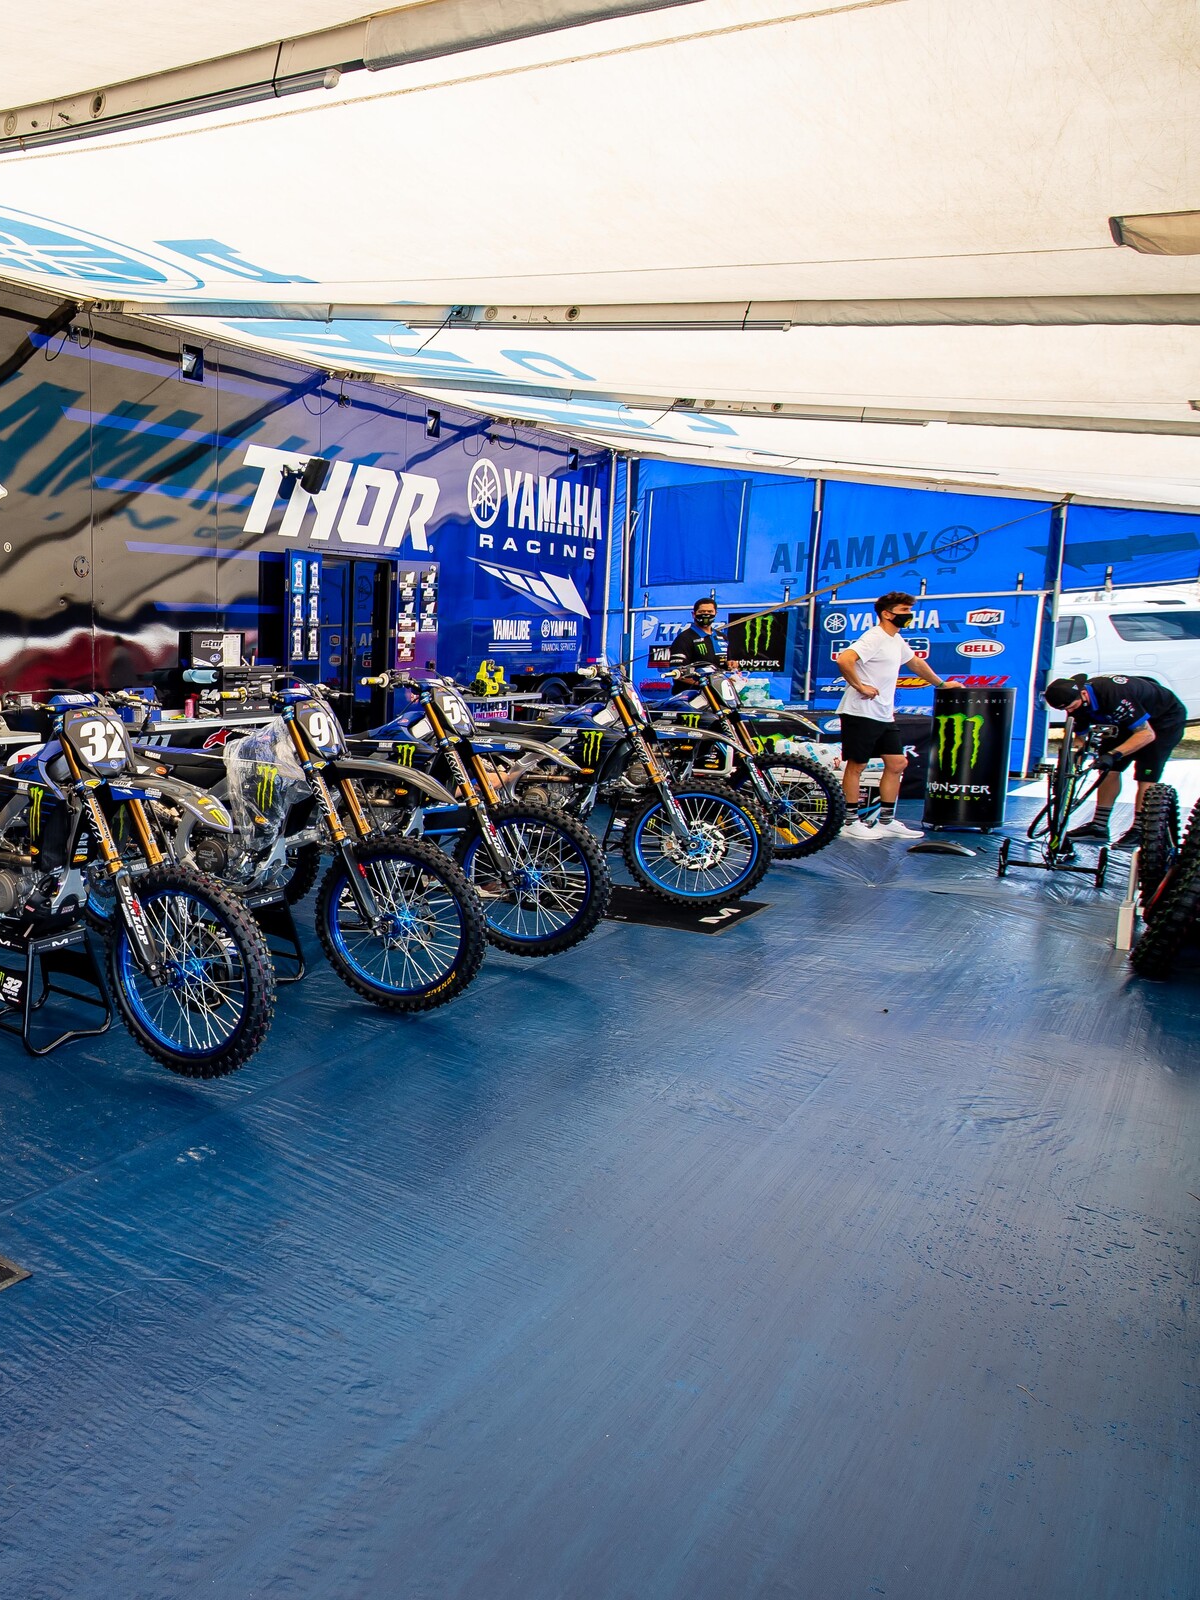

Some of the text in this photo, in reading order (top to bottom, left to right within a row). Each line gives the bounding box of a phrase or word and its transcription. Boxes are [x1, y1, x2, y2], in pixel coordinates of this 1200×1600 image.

[242, 444, 437, 551] THOR
[504, 468, 602, 540] YAMAHA
[479, 533, 595, 561] RACING
[850, 610, 940, 631] YAHA
[971, 612, 999, 623] 100%
[492, 619, 532, 640] YAMALUBE
[550, 621, 577, 637] YAMAHA
[964, 645, 996, 653] BELL
[474, 711, 507, 719] UNLIMITED
[80, 720, 126, 763] 32
[926, 782, 991, 795] MONSTER
[740, 805, 762, 835] DUNLOP
[3, 976, 23, 993] 32
